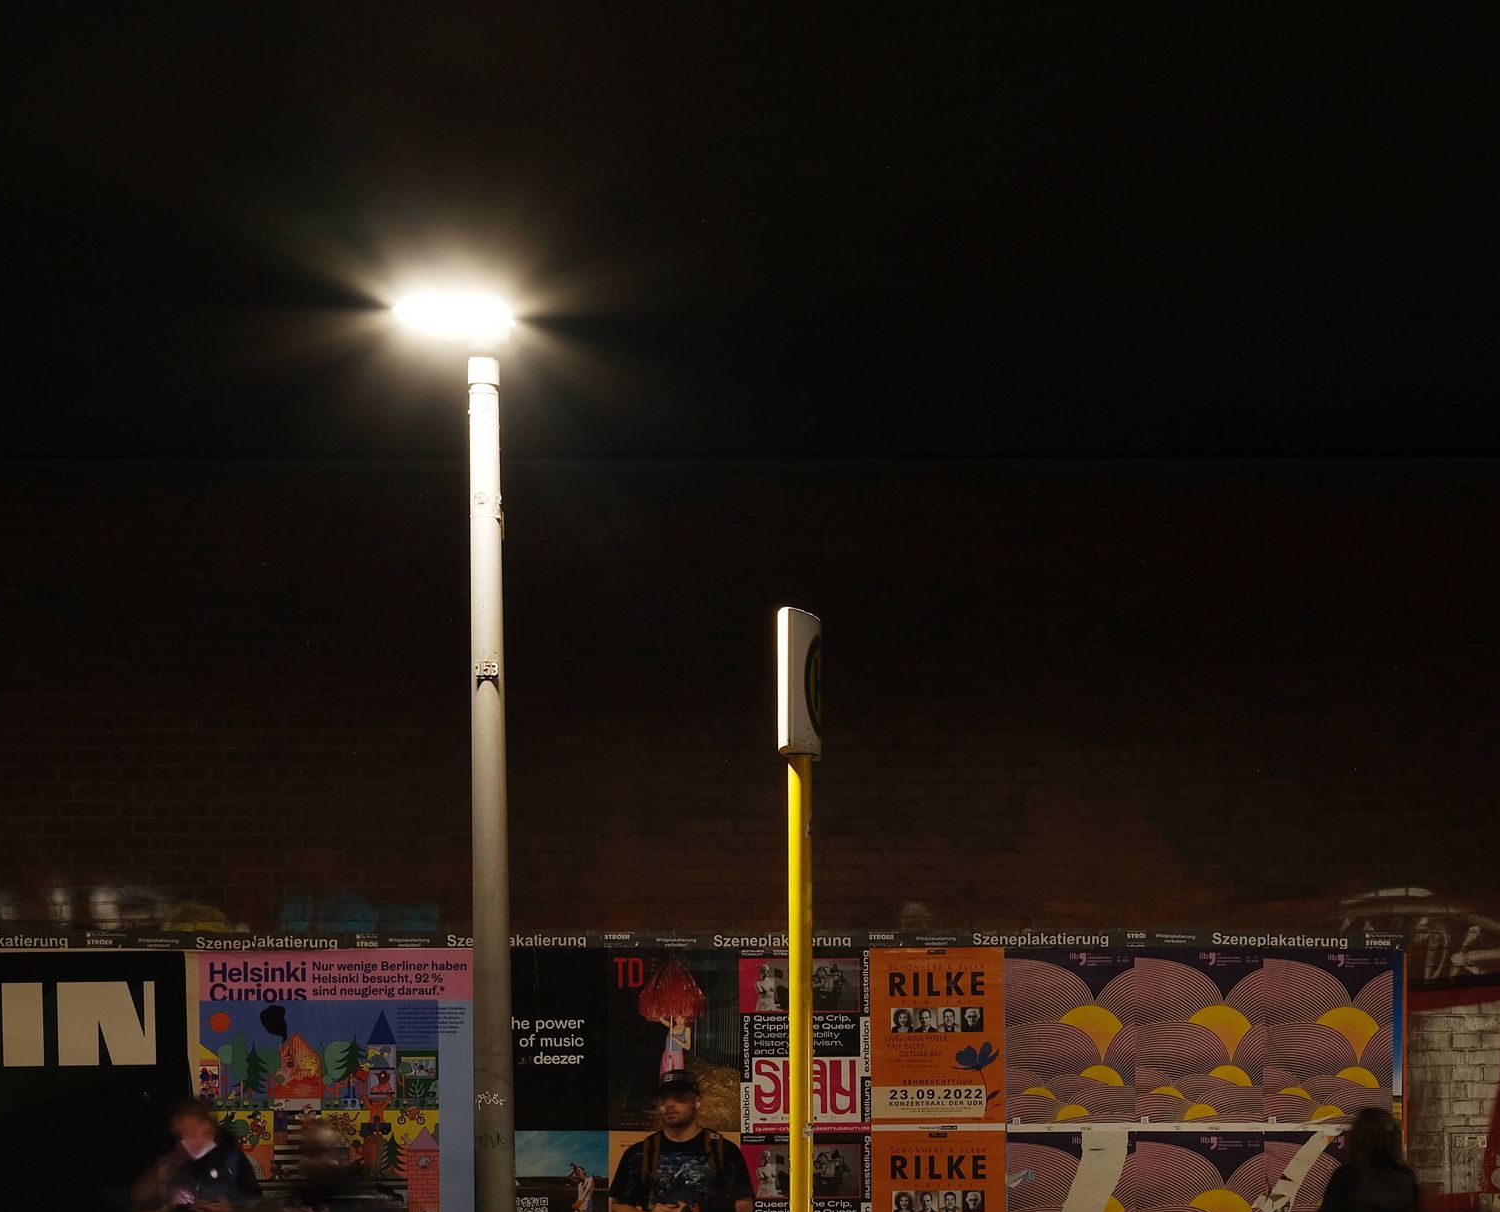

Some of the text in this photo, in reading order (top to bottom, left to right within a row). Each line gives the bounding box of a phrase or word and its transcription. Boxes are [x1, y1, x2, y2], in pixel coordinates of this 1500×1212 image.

[972, 932, 1110, 947] Szeneplakatierung
[1212, 932, 1348, 949] Szeneplakatierung
[210, 962, 306, 982] Helsinki
[312, 961, 466, 974] Nur wenige Berliner haben
[312, 974, 412, 984] Helsinki besucht,
[889, 972, 985, 996] RILKE
[210, 983, 307, 1002] Curious
[312, 986, 329, 996] sind
[332, 986, 394, 998] neugierig
[511, 1017, 585, 1032] he power
[823, 1022, 855, 1030] Queer
[519, 1034, 584, 1048] of music
[533, 1052, 584, 1065] deezer
[890, 1089, 982, 1099] 23.09.2022
[891, 1155, 986, 1180] RILKE
